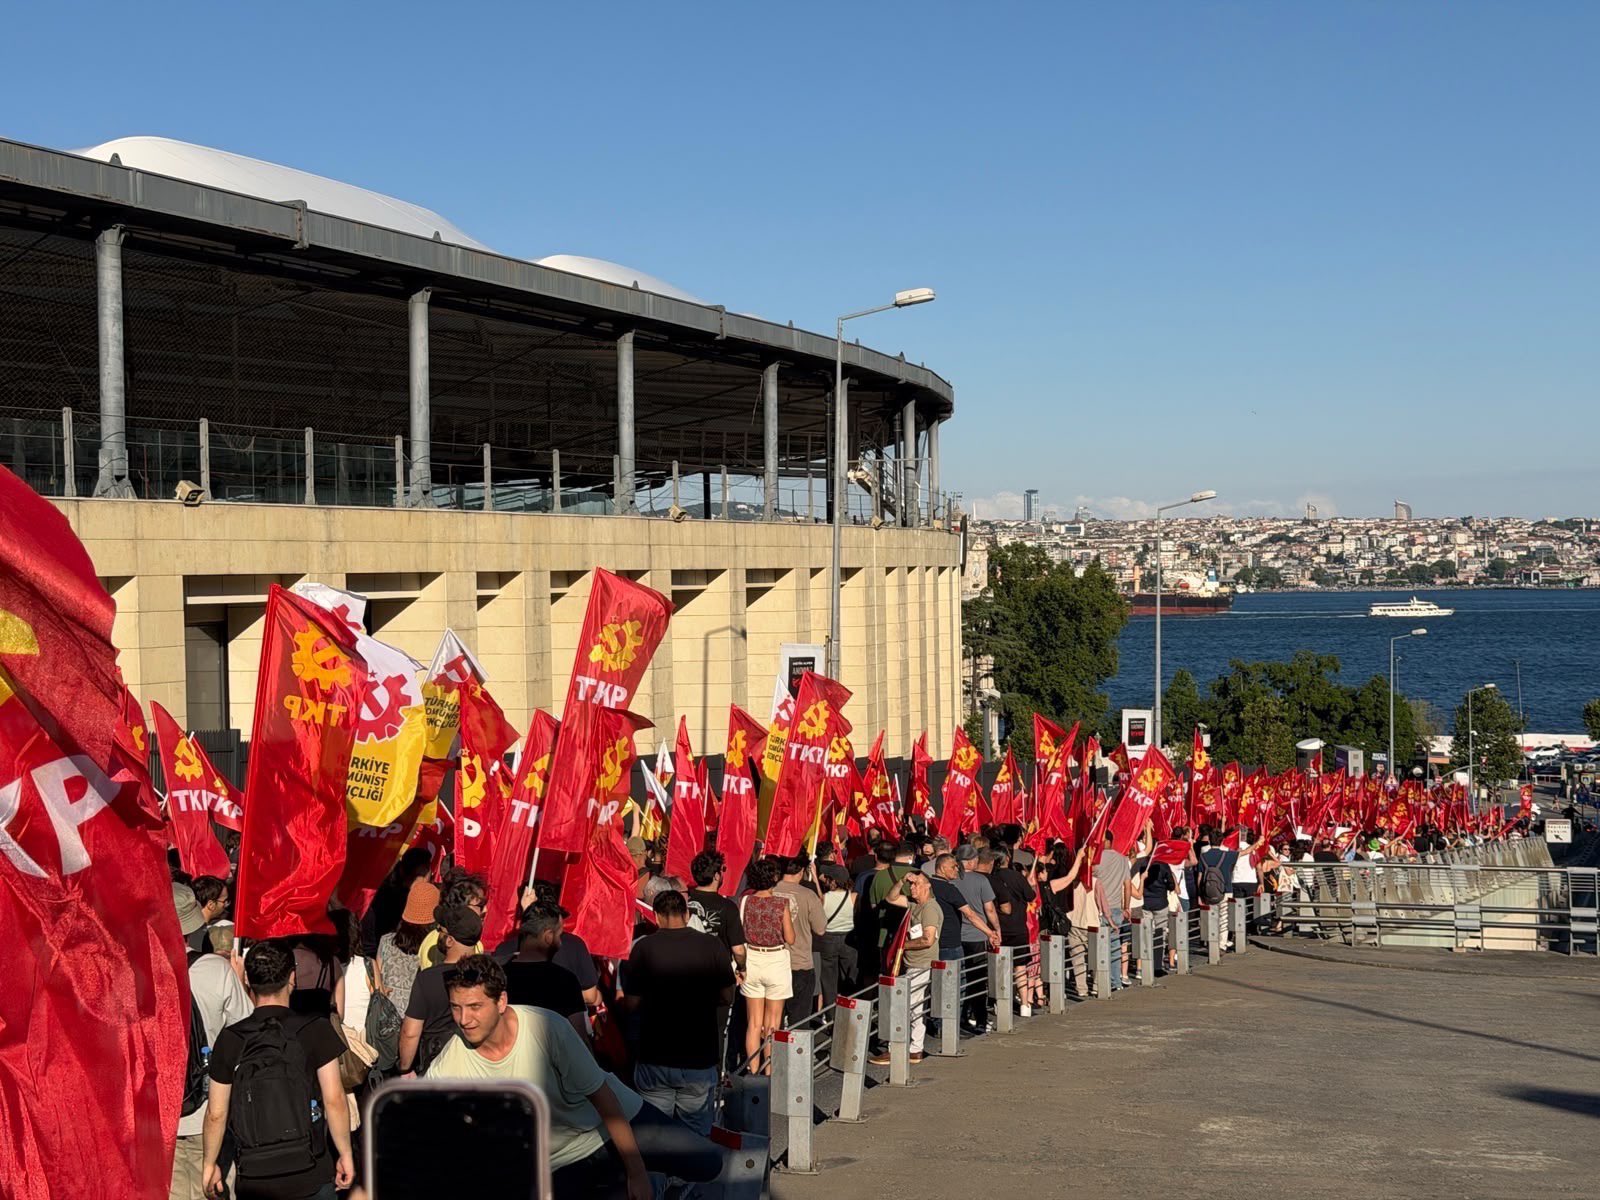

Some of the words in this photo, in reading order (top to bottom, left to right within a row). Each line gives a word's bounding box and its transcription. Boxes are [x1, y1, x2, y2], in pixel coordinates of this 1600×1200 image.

[575, 675, 627, 709] TKP
[769, 735, 786, 746] TÜRK
[789, 742, 824, 764] TKP
[350, 756, 390, 775] RKİYE
[722, 774, 753, 795] TKP
[952, 769, 972, 788] TKP
[1127, 786, 1155, 808] TKP
